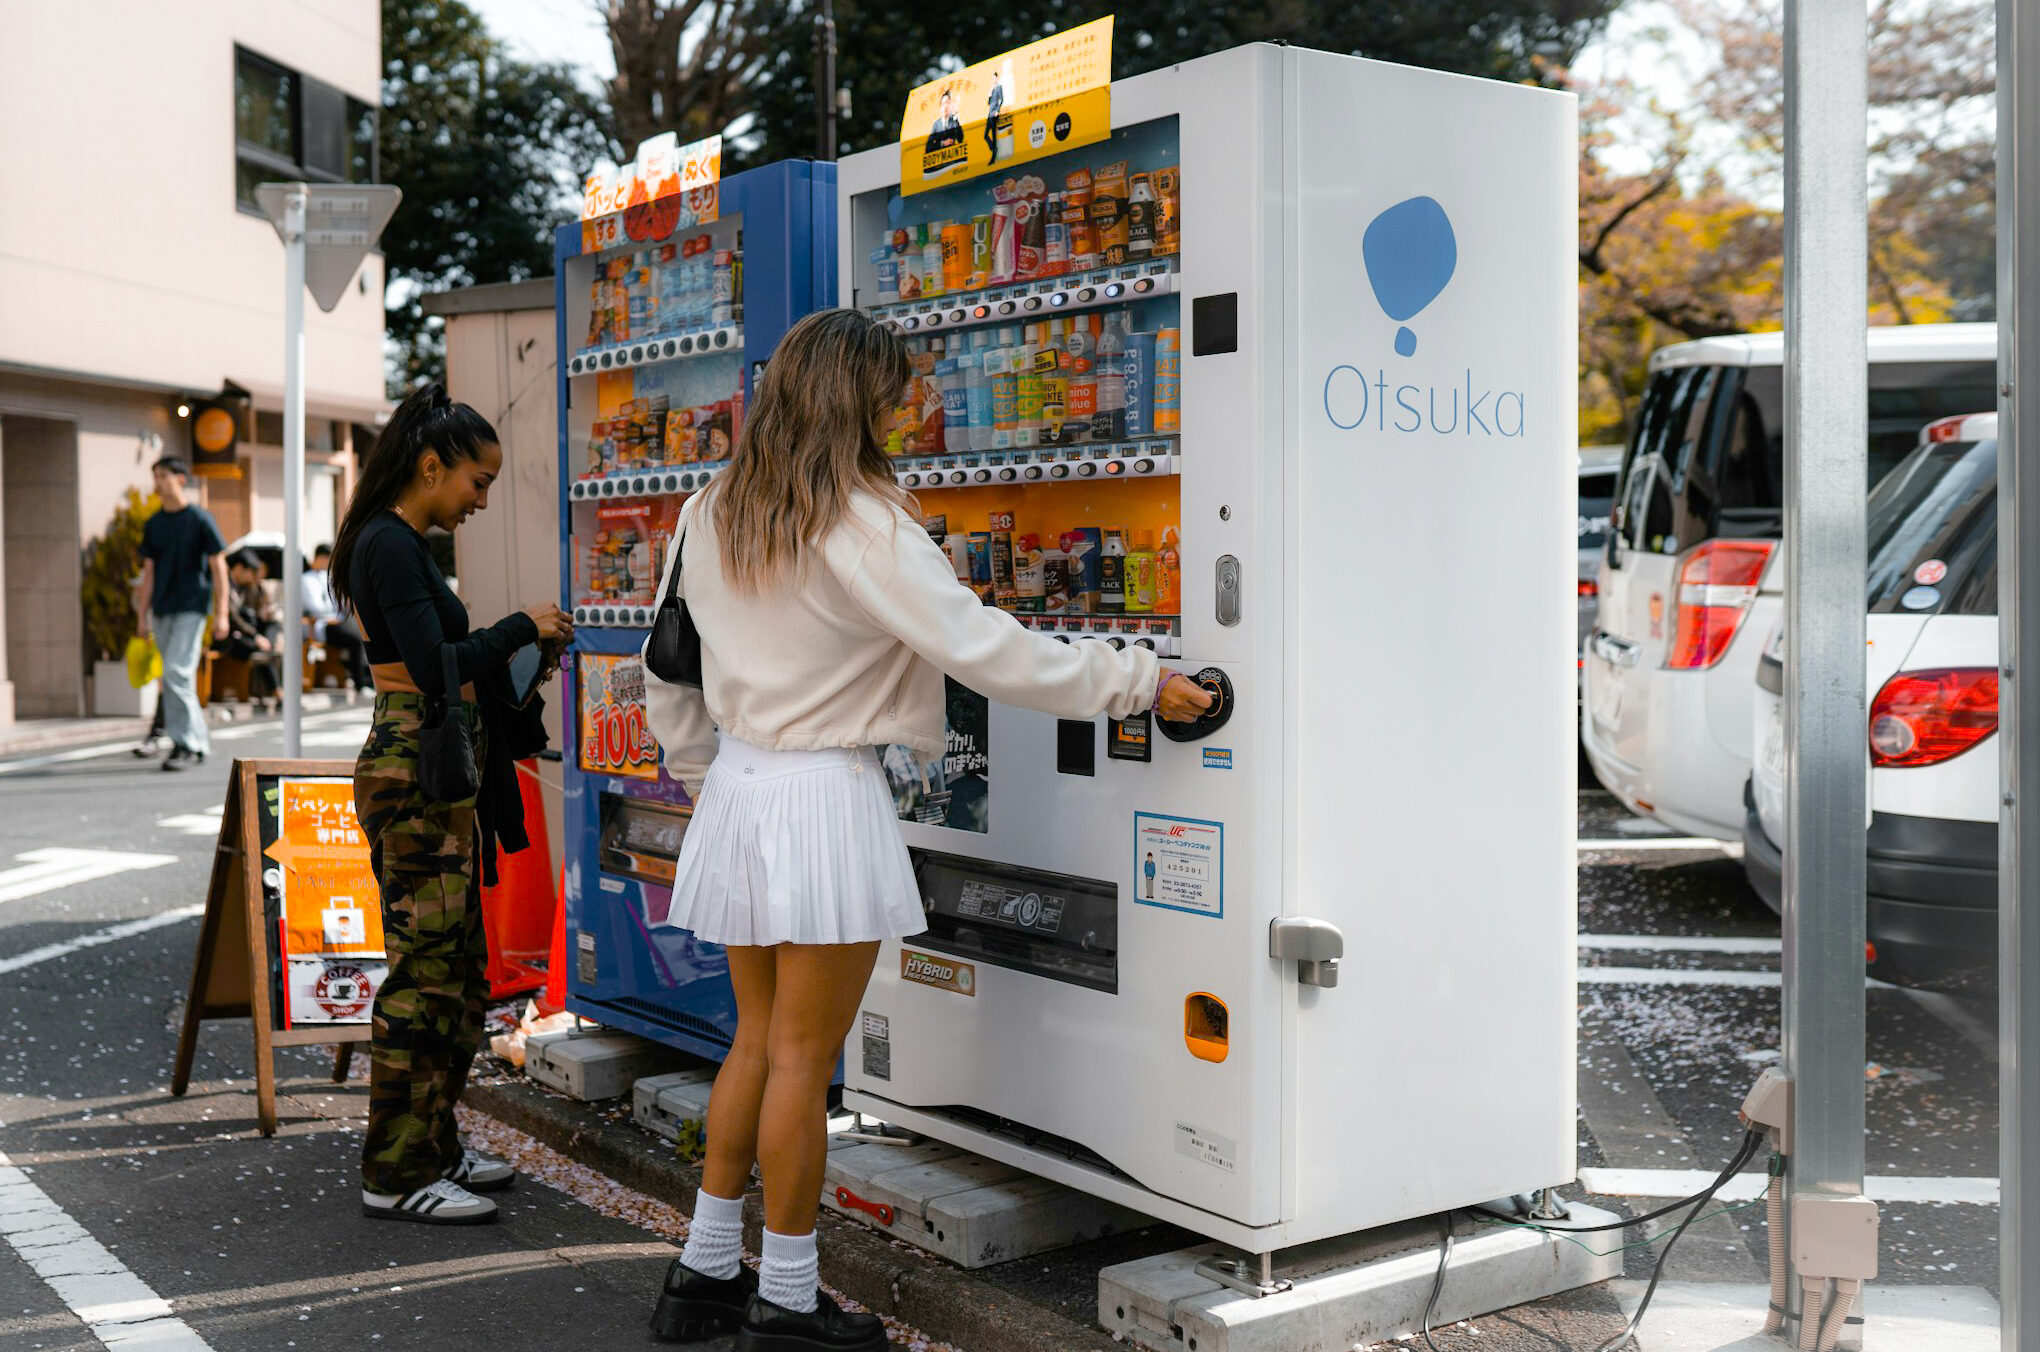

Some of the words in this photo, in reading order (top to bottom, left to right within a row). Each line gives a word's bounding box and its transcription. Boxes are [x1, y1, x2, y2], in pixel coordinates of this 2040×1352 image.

[922, 142, 969, 168] BODYMAINTE
[1127, 348, 1140, 431] POCARI
[1324, 364, 1524, 437] Otsuka
[320, 966, 369, 986] COFFEE
[904, 958, 953, 981] HYBRID
